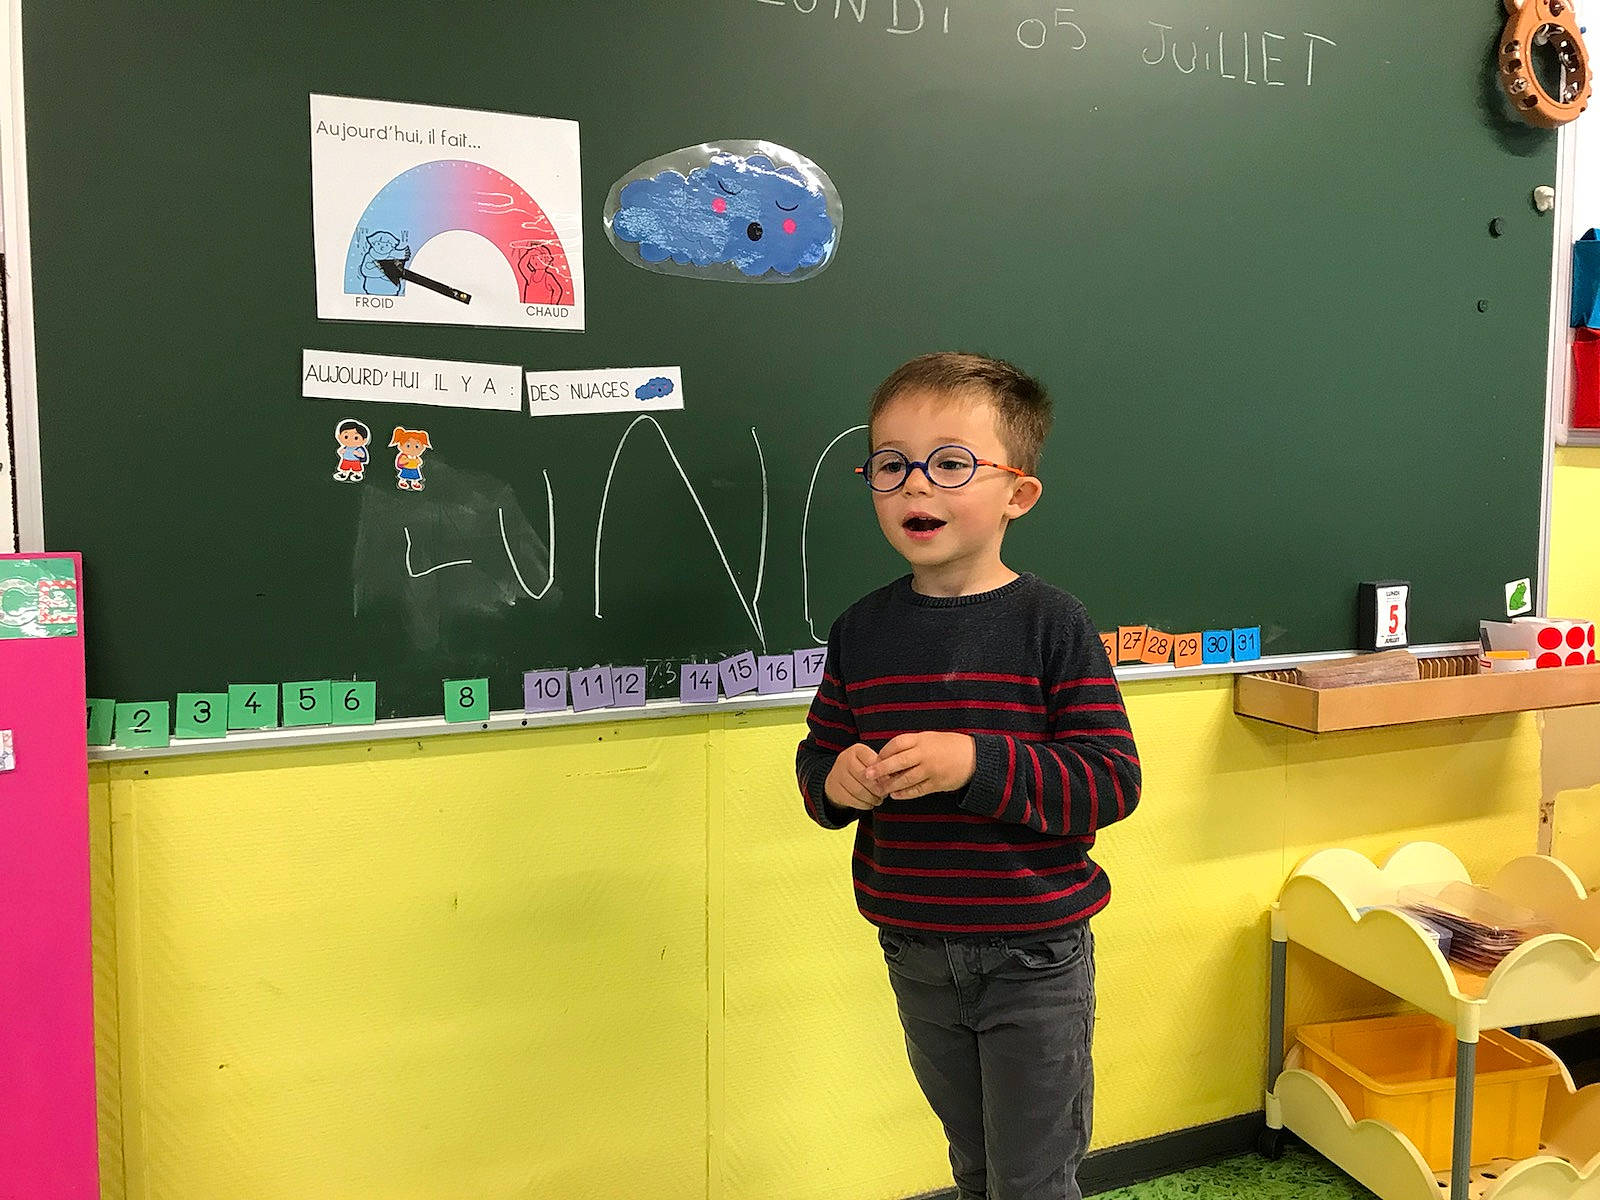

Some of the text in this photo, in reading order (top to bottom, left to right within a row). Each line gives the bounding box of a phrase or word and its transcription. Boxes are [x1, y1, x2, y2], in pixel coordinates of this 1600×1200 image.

[1016, 8, 1087, 50] 05
[316, 120, 424, 145] Aujourd'hui,
[427, 128, 436, 145] il
[355, 296, 394, 309] FROID
[526, 306, 569, 318] CHAUD
[434, 374, 449, 392] IL
[461, 375, 474, 392] Y
[483, 378, 496, 394] A
[531, 382, 629, 401] DES NUAGES
[1388, 604, 1399, 634] 5
[1104, 639, 1112, 656] 6
[1123, 631, 1143, 650] 27
[1147, 636, 1168, 655] 28
[1178, 638, 1198, 657] 29
[1207, 635, 1228, 653] 30
[1238, 633, 1255, 651] 31
[728, 657, 752, 682] 15
[767, 662, 788, 681] 16
[803, 653, 825, 674] 17
[534, 677, 561, 699] 10
[580, 674, 604, 697] 11
[615, 673, 639, 694] 12
[689, 669, 713, 690] 14
[244, 691, 262, 715] 4
[299, 688, 316, 711] 5
[344, 688, 360, 711] 6
[459, 687, 474, 707] 8
[133, 709, 152, 733] 2
[193, 700, 211, 724] 3
